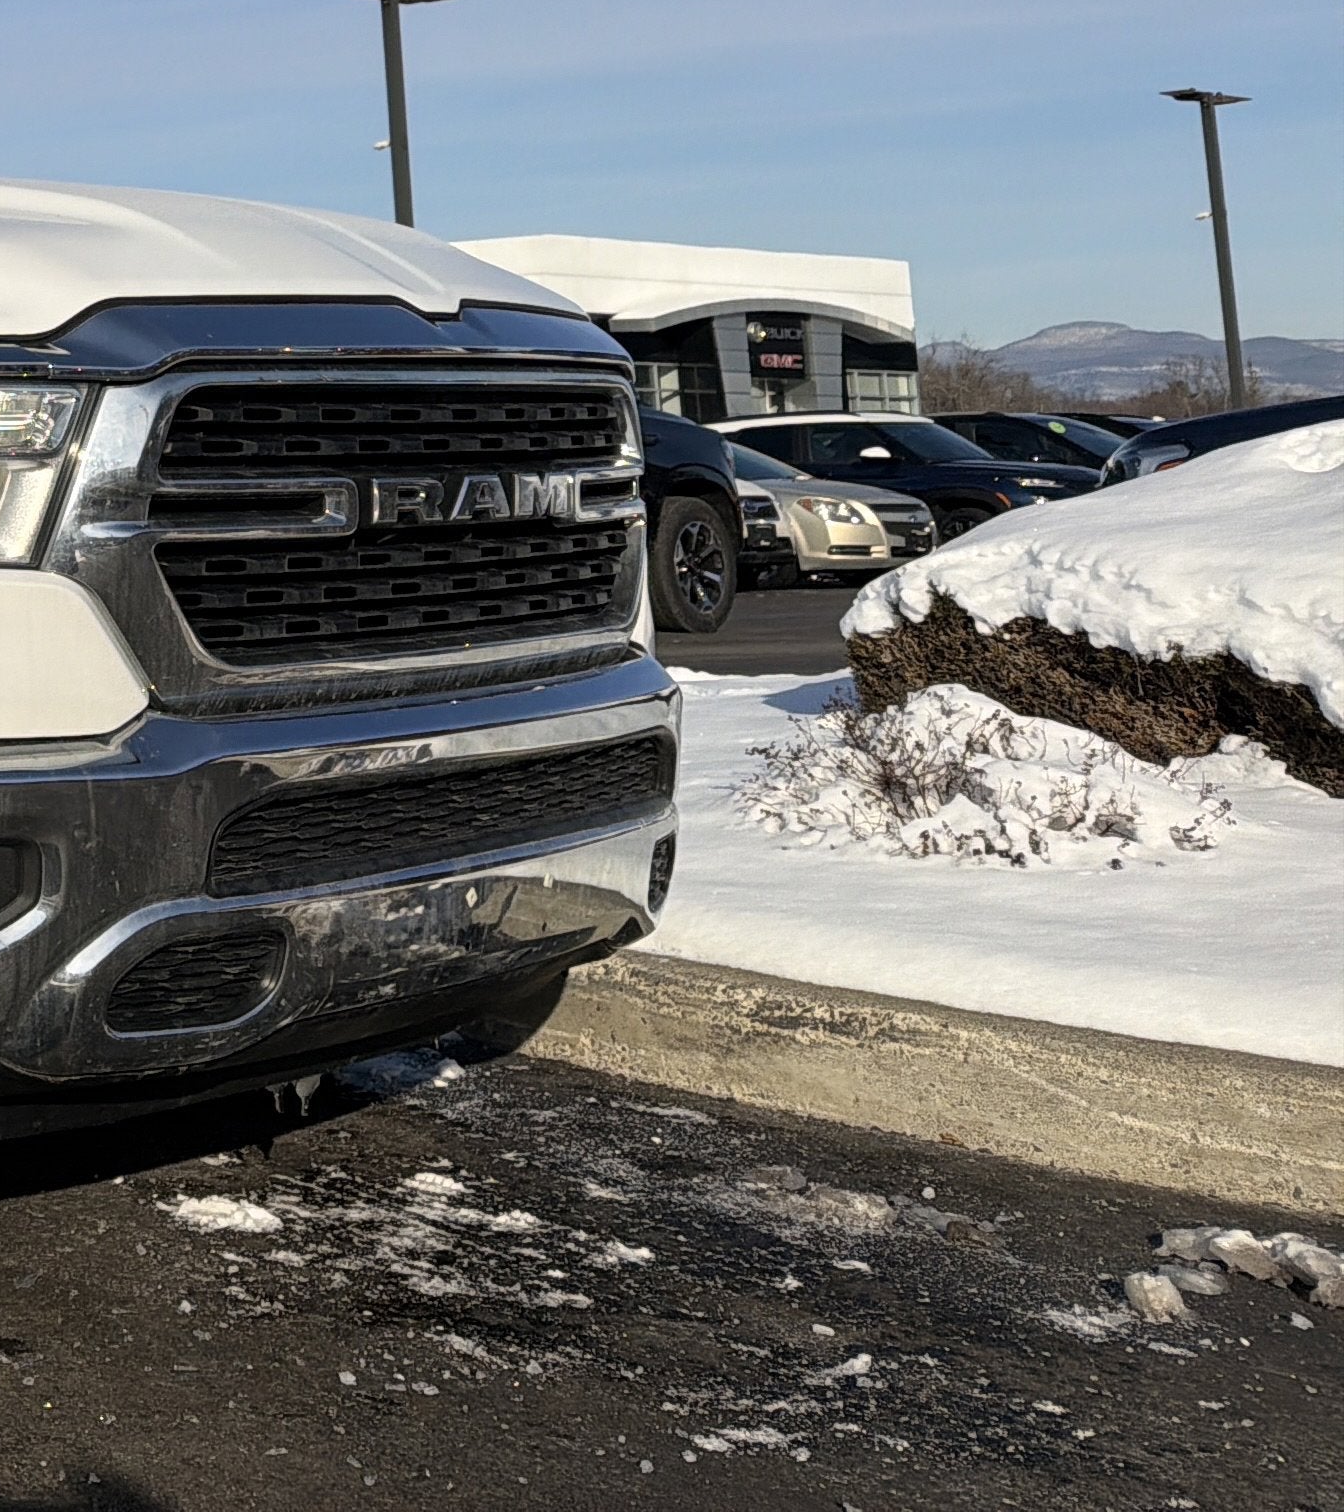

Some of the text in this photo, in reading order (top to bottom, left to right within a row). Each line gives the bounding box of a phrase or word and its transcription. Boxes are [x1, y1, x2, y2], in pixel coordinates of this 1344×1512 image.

[767, 327, 804, 340] BUICK
[760, 353, 803, 369] GMC
[372, 472, 576, 525] RAM
